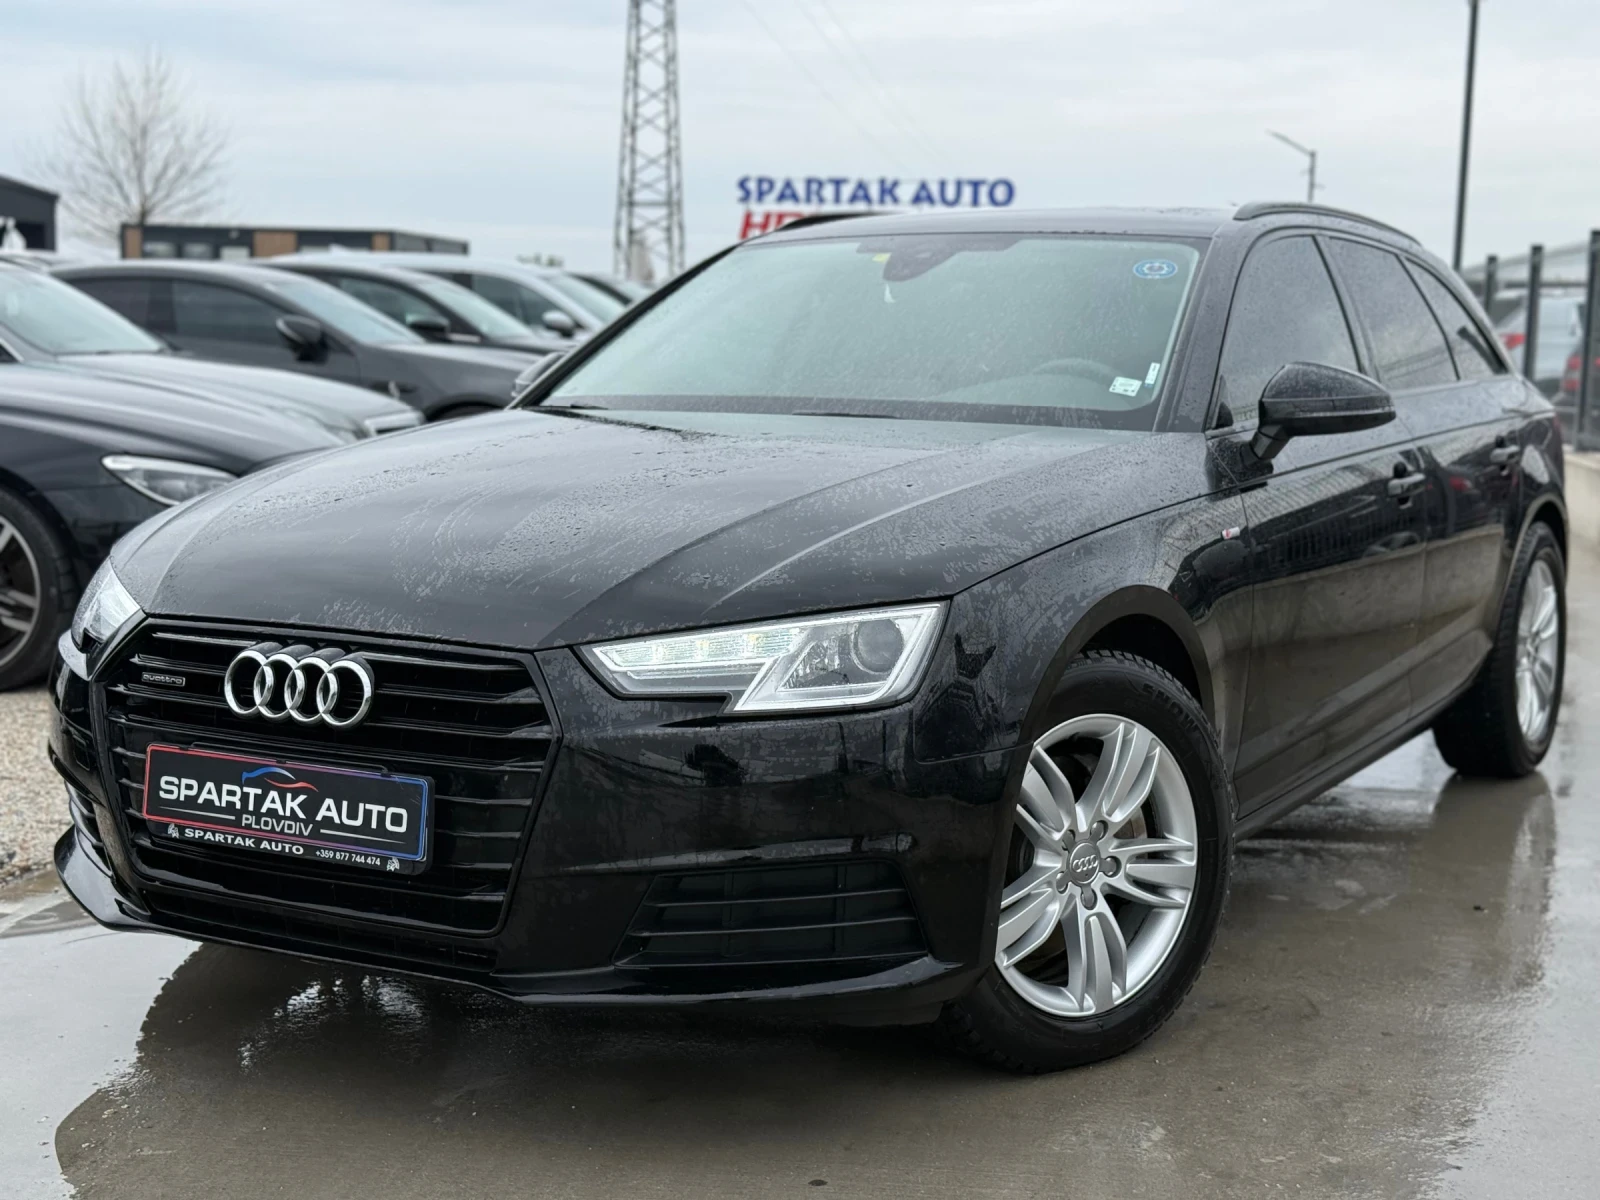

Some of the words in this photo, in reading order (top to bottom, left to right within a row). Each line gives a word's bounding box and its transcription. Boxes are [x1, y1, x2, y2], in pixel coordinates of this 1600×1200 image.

[737, 176, 900, 204] SPARTAK
[911, 177, 1016, 207] AUTO
[142, 674, 183, 685] quattro
[159, 775, 308, 819] SPARTAK
[316, 798, 408, 833] AUTO
[241, 814, 313, 836] PLOVDIV
[184, 828, 256, 848] SPARTAK
[260, 840, 304, 855] AUTO
[315, 849, 334, 859] +359
[335, 851, 349, 861] 877
[351, 853, 365, 863] 744
[366, 856, 381, 866] 474
